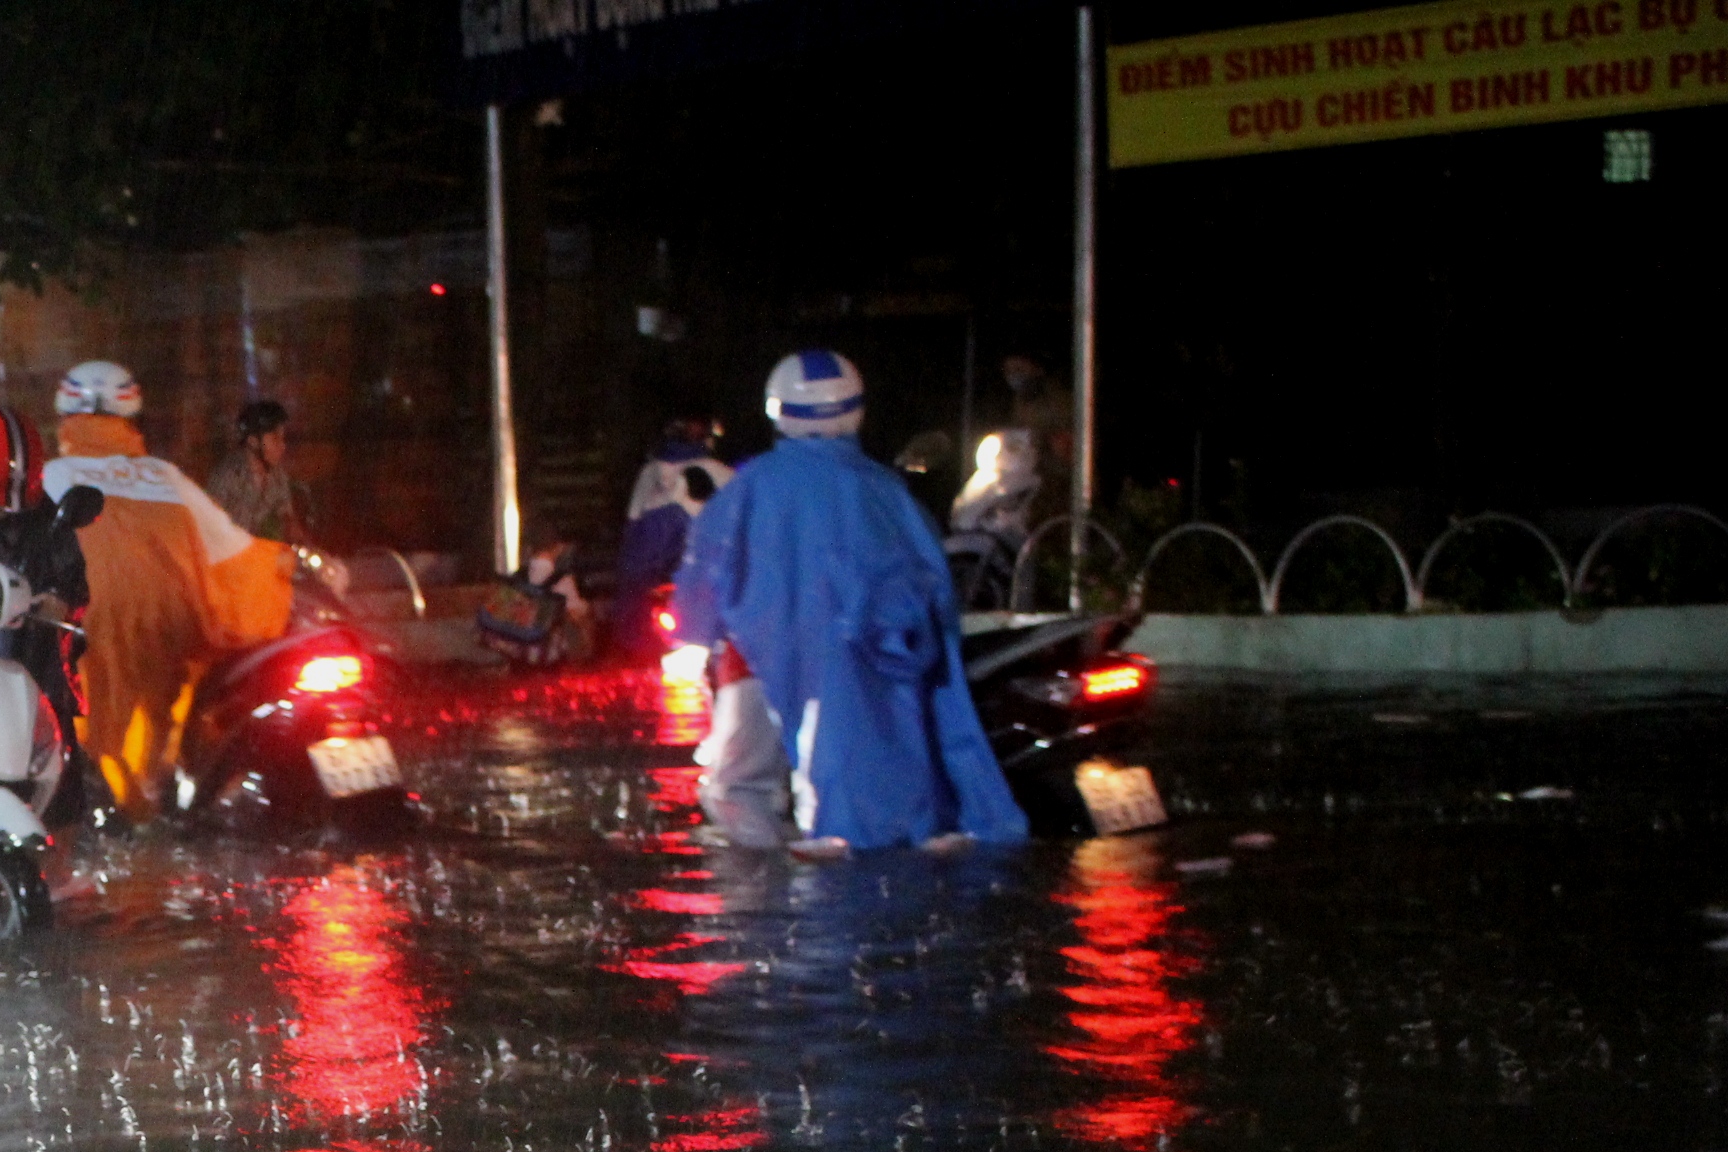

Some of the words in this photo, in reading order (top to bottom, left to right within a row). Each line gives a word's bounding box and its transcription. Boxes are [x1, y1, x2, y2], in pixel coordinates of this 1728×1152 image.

[1224, 42, 1315, 82] SINH
[1328, 27, 1429, 69] HOẠT
[1542, 1, 1622, 46] LẠC
[1316, 75, 1435, 127] CHIẾN
[1451, 69, 1550, 112] BINH
[1565, 57, 1653, 99] KHU
